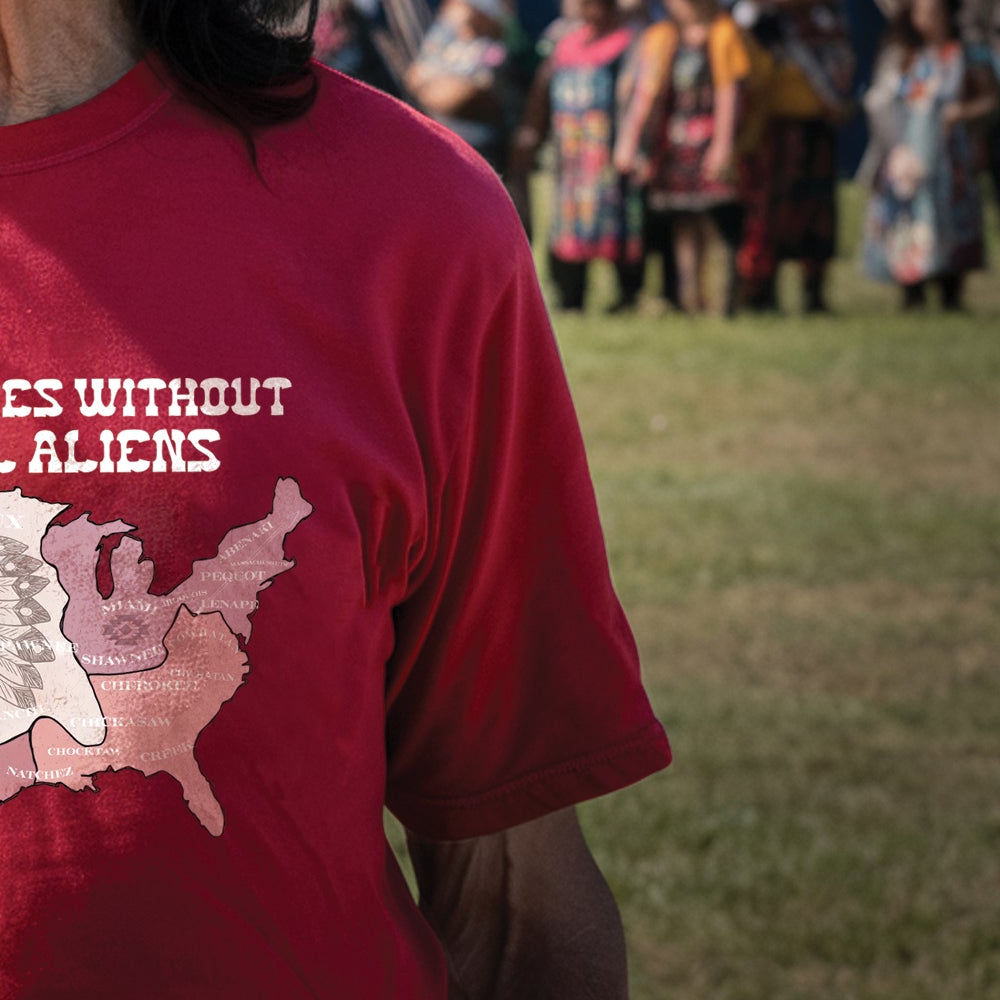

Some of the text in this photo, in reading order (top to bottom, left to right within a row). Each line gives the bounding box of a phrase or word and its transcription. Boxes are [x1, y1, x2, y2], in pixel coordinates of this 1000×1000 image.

[74, 377, 292, 417] WITHOUT
[28, 429, 221, 473] ALIENS
[219, 521, 274, 561] ABENAKI
[200, 571, 267, 583] PEQUOT
[101, 599, 158, 616] MIAMI
[81, 644, 166, 666] SHAWNEE
[70, 717, 173, 728] CHICKASAW
[6, 766, 74, 780] NATCHEZ
